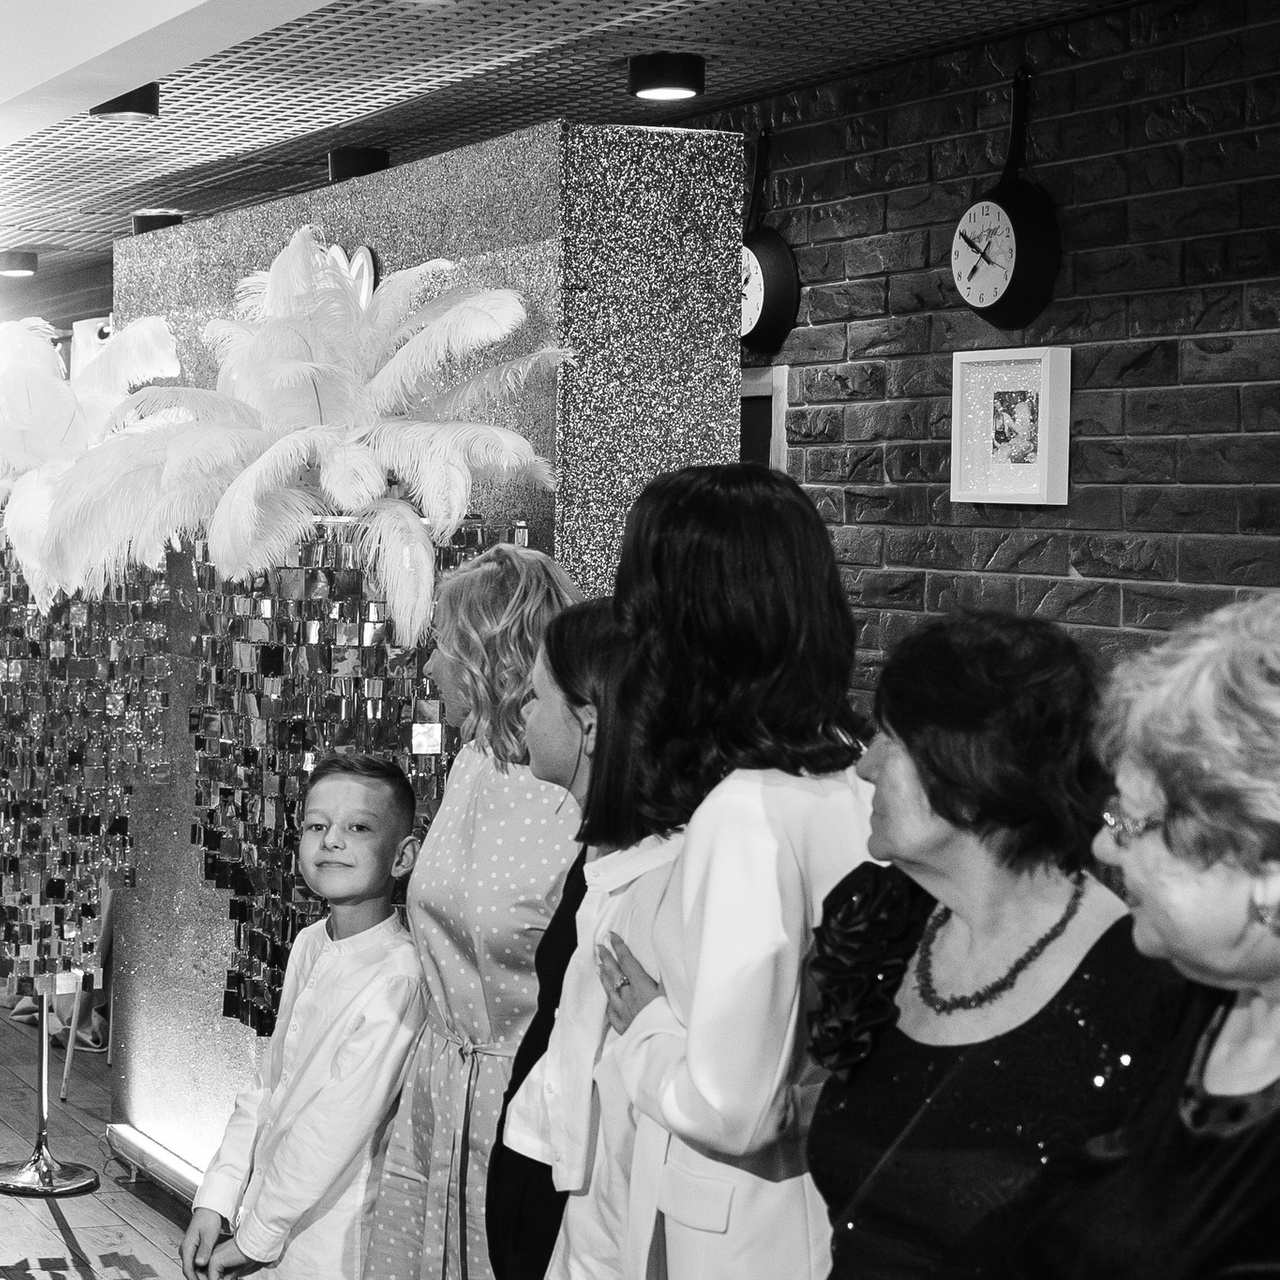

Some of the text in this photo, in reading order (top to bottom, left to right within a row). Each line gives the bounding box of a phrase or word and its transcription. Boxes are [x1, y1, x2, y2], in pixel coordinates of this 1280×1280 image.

[981, 205, 990, 216] 12
[968, 212, 976, 223] 11
[1005, 227, 1011, 238] 2
[954, 249, 960, 261] 9
[1008, 248, 1014, 259] 3
[957, 270, 962, 281] 8
[1003, 270, 1008, 281] 4
[966, 286, 972, 298] 7
[978, 292, 985, 303] 6
[992, 286, 998, 298] 5
